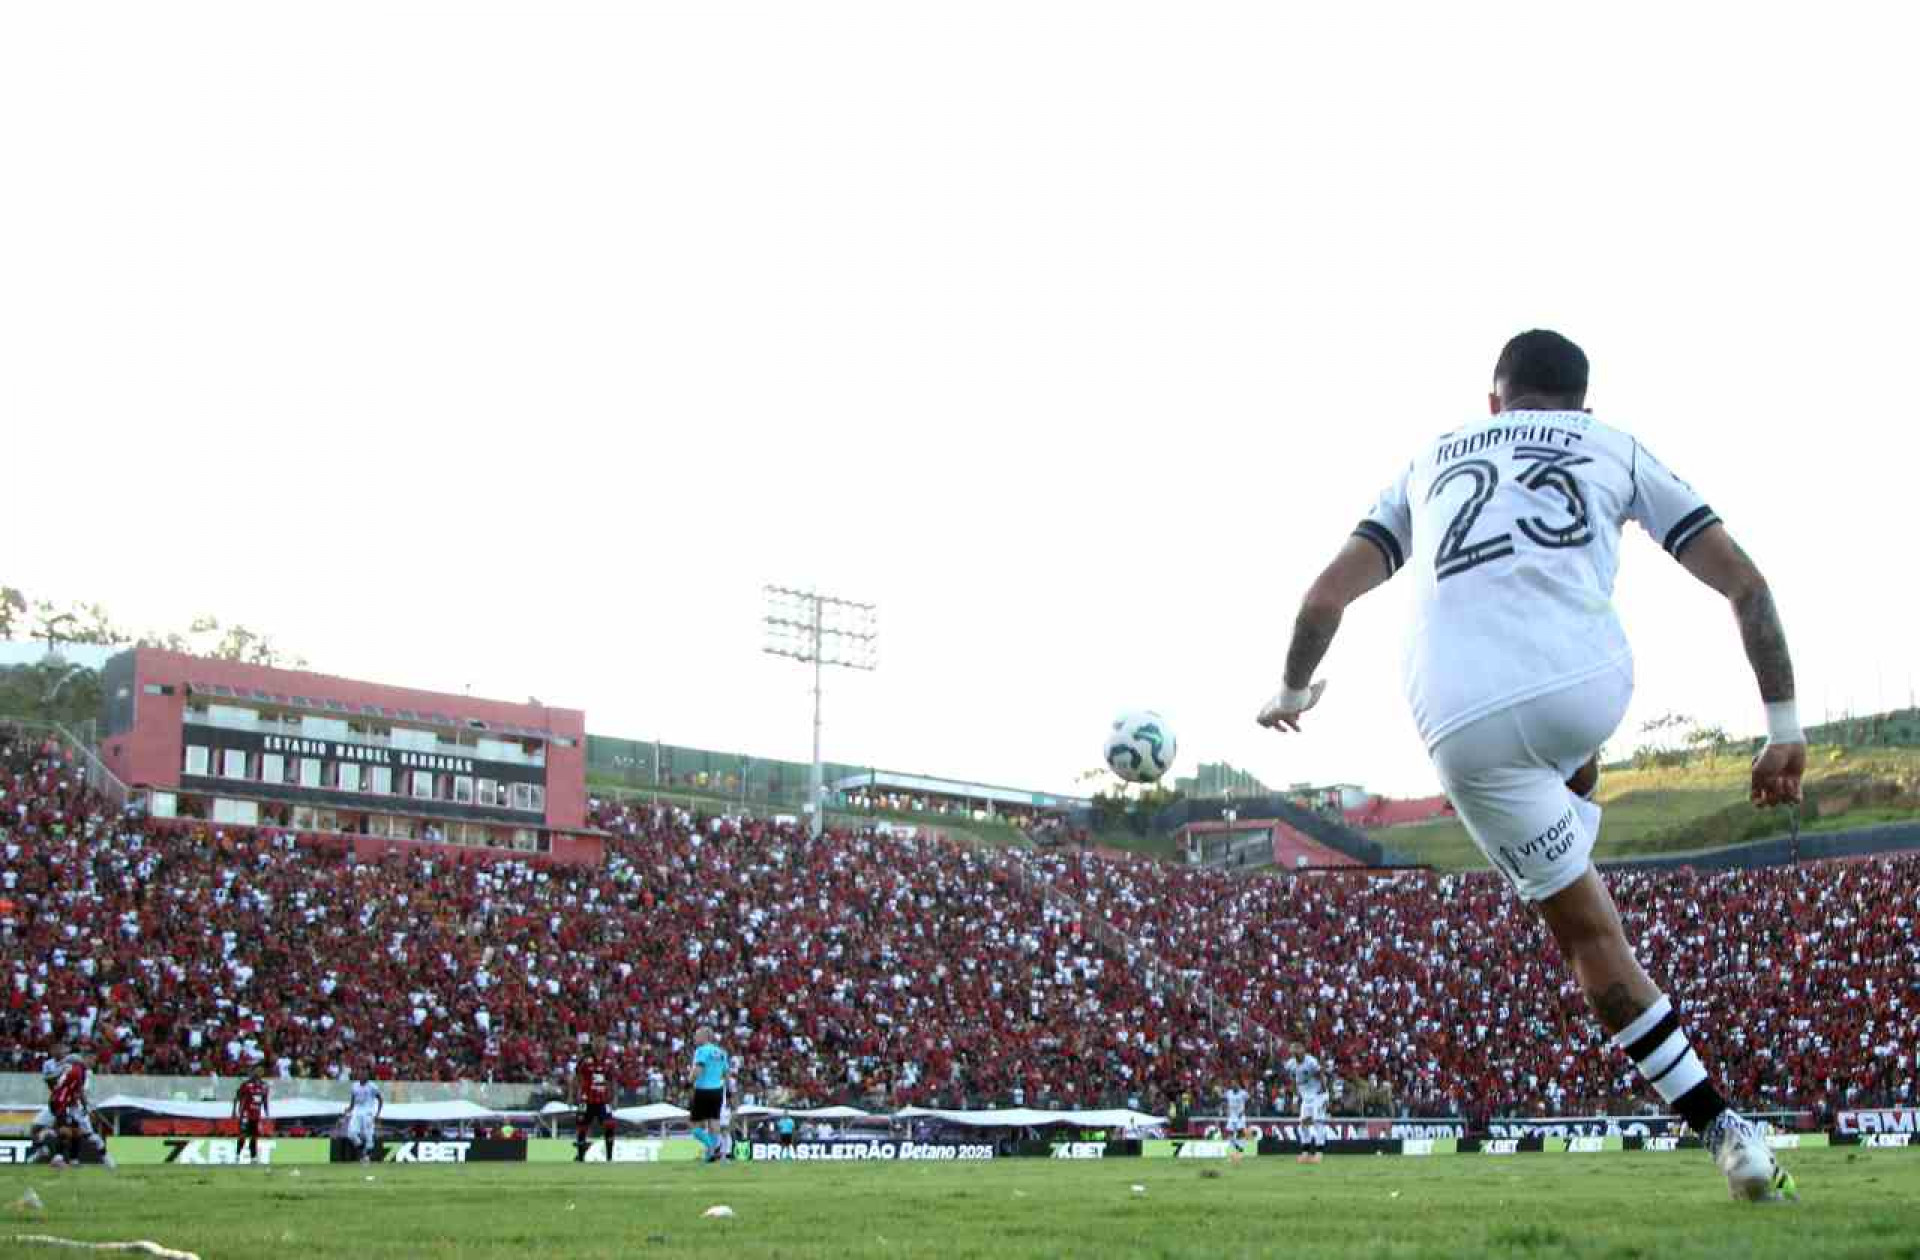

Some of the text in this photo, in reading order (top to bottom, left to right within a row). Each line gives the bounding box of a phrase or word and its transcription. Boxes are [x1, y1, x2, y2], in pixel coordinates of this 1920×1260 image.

[1425, 446, 1596, 583] 23
[752, 1139, 895, 1159] BRASILEIRÃO
[957, 1145, 994, 1159] 2025
